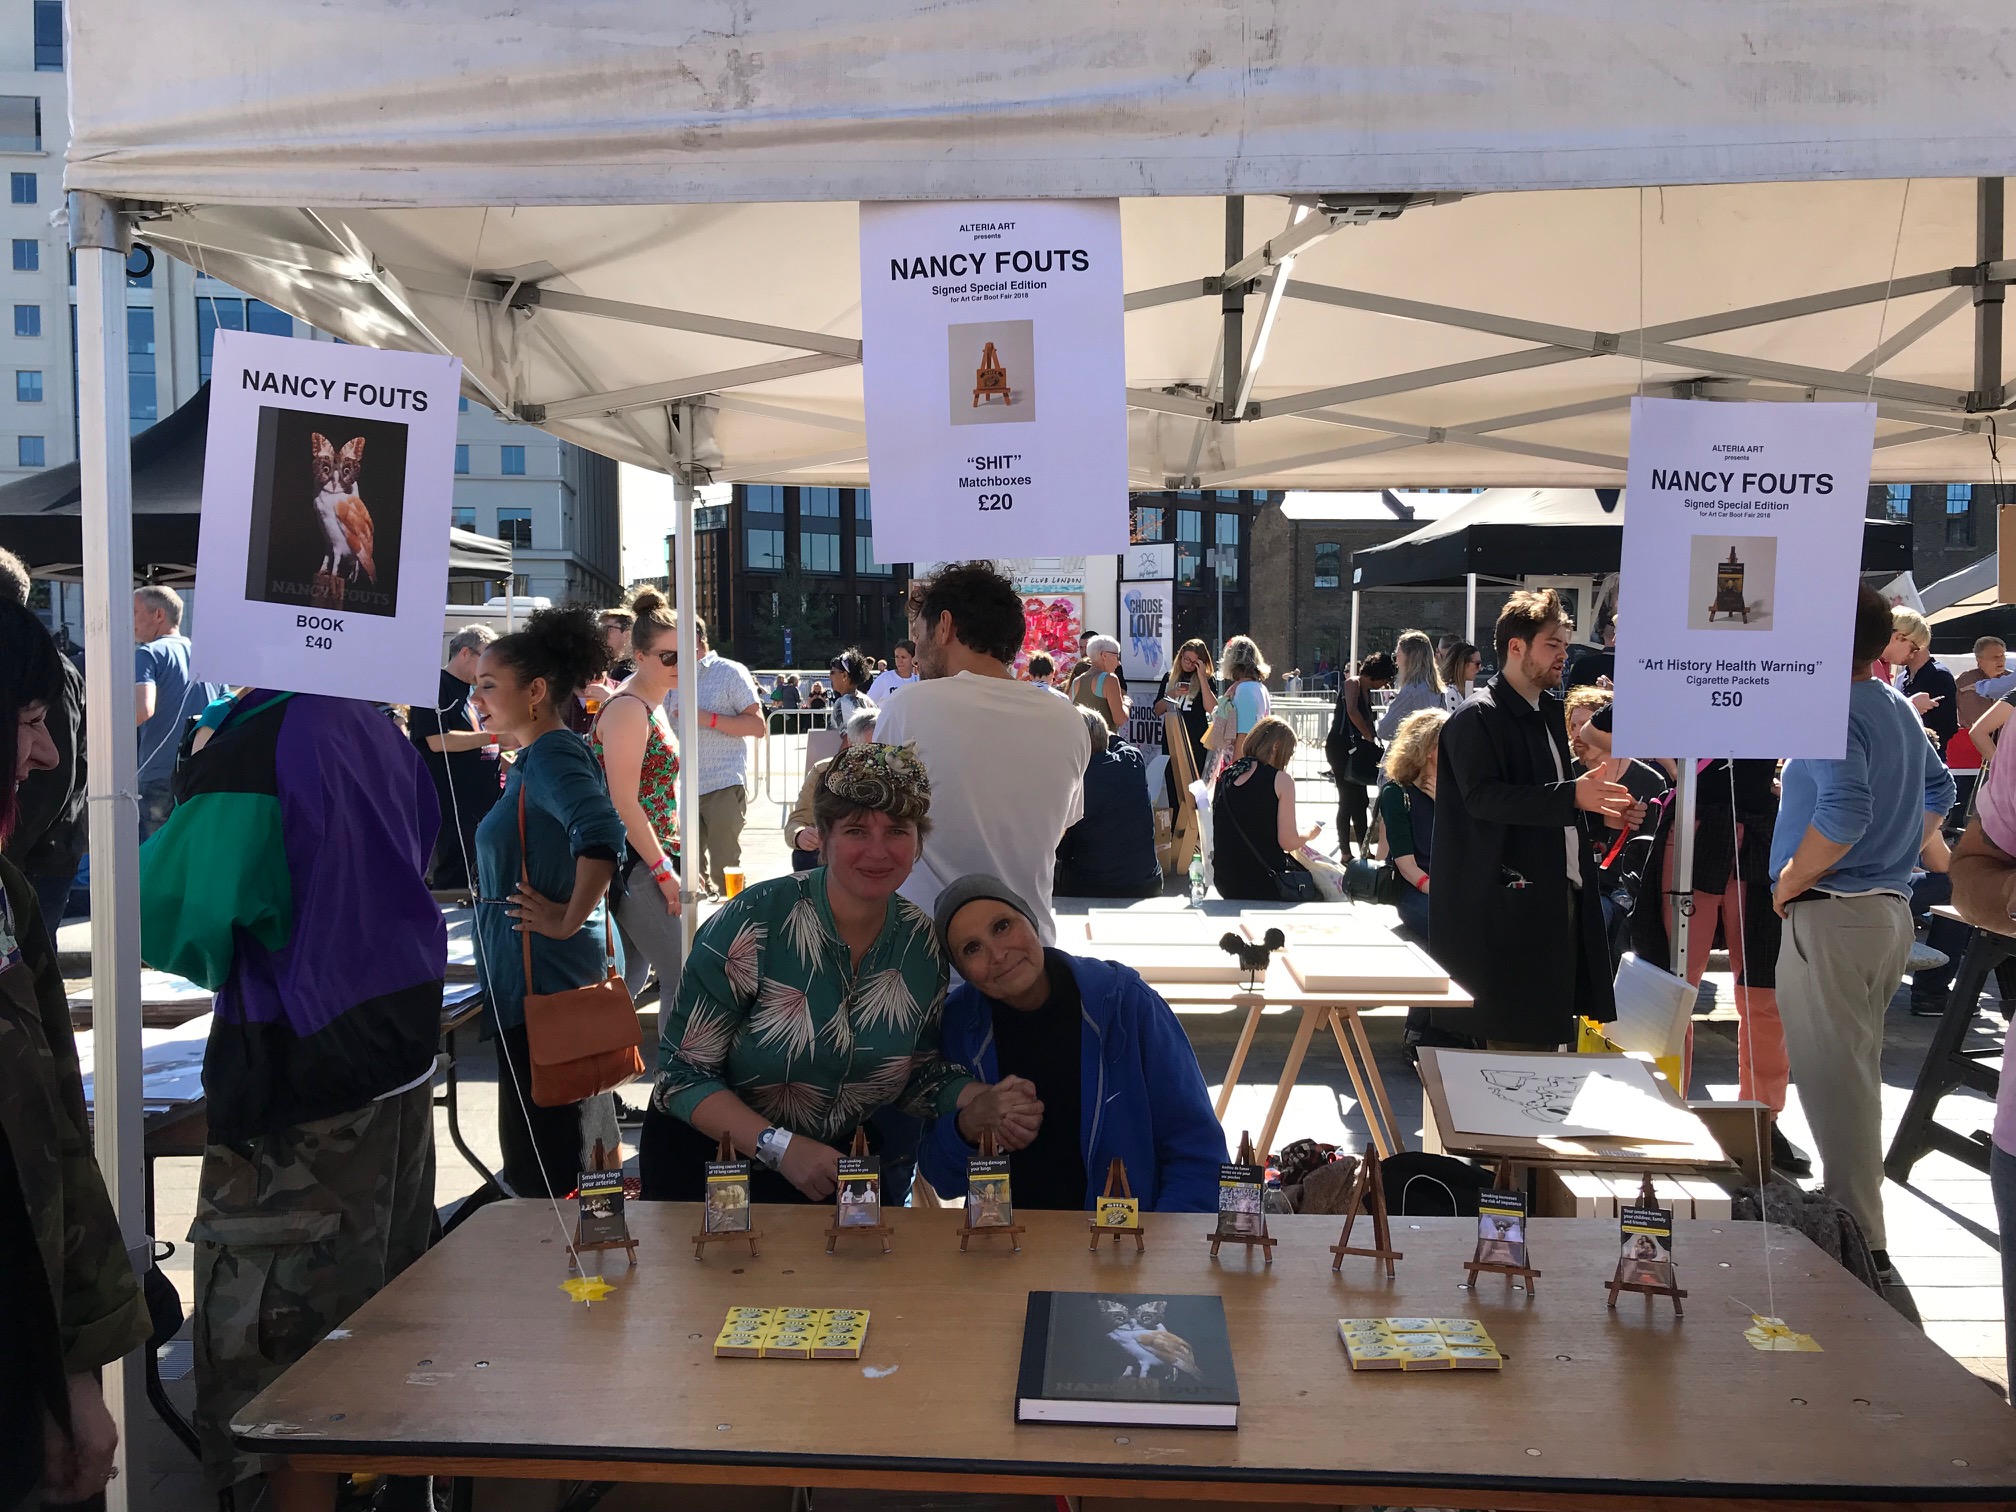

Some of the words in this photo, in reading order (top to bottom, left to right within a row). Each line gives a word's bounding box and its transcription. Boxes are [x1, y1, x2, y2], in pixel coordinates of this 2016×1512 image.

[959, 222, 996, 232] ALTERIA
[997, 222, 1016, 231] ART
[973, 233, 1002, 242] presents
[891, 253, 986, 280] NANCY
[996, 250, 1089, 273] FOUTS
[932, 284, 966, 296] Signed
[970, 282, 1007, 294] Special
[1010, 280, 1047, 290] Edition
[960, 295, 970, 303] Art
[243, 369, 336, 399] NANCY
[344, 382, 427, 411] FOUTS
[1711, 444, 1746, 453] ALTERIA
[1746, 445, 1765, 453] ART
[959, 476, 1031, 487] Matchboxes
[1652, 469, 1734, 492] NANCY
[1743, 473, 1833, 494] FOUTS
[979, 494, 1012, 511] £20
[1685, 499, 1715, 510] Signed
[1718, 500, 1751, 510] Special
[1754, 501, 1789, 511] Edition
[1130, 599, 1163, 613] CHOOSE
[297, 615, 344, 632] BOOK
[1130, 614, 1163, 638] LOVE
[306, 636, 332, 649] £40
[1668, 659, 1712, 673] History
[1717, 660, 1756, 671] Health
[1687, 676, 1729, 686] Cigarette
[1732, 676, 1769, 685] Packets
[1712, 691, 1742, 706] £50
[1129, 721, 1163, 745] LOVE
